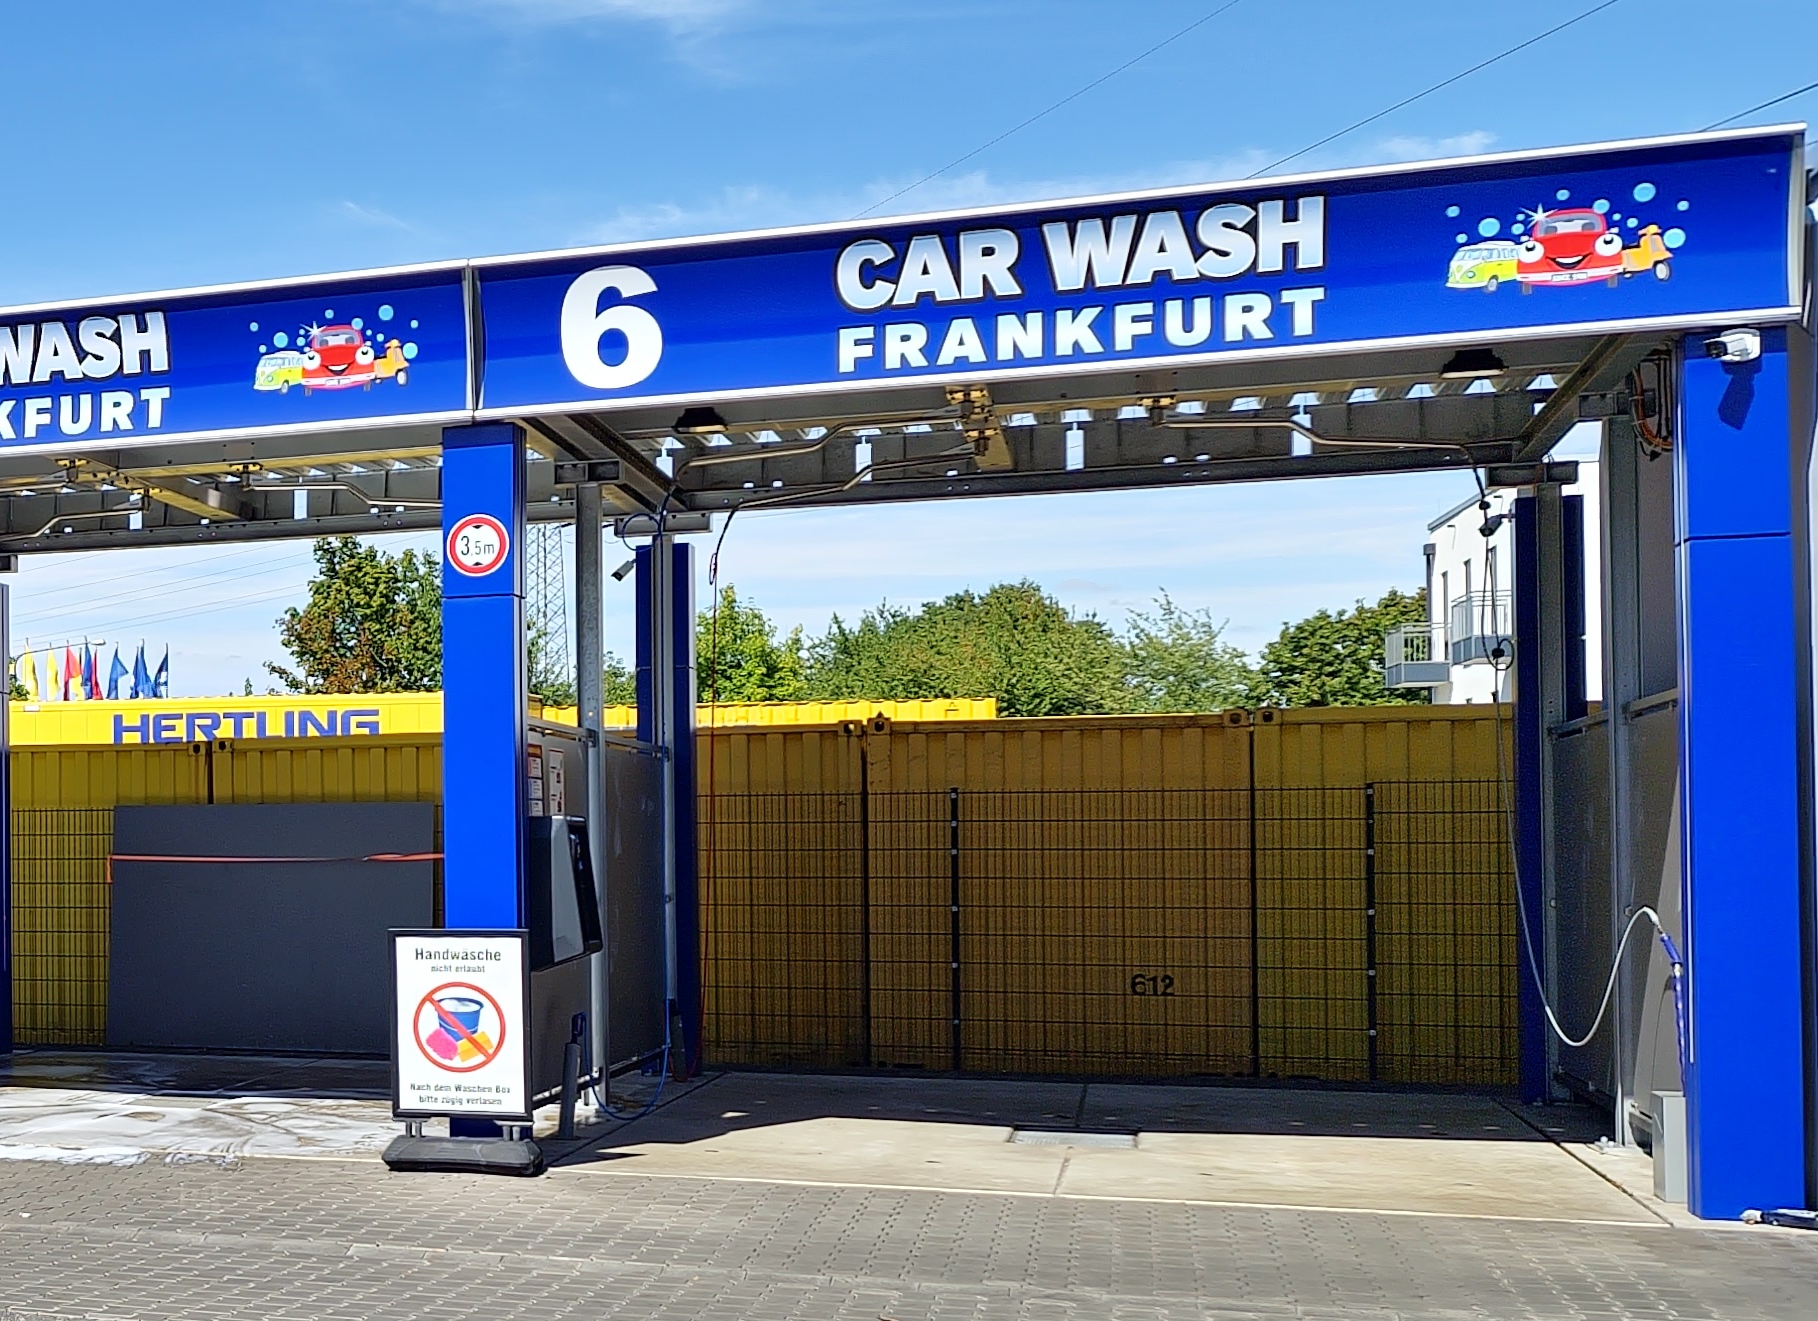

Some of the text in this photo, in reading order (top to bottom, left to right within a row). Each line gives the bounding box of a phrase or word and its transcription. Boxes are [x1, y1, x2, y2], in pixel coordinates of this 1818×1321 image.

[834, 194, 1327, 311] CAR WASH
[559, 264, 664, 391] 6
[836, 286, 1326, 375] FRANKFURT
[113, 709, 380, 744] HERTLING
[414, 948, 502, 961] Handwäsche
[1130, 973, 1175, 996] 612
[410, 1083, 431, 1091] Nach
[419, 1095, 438, 1103] bitte
